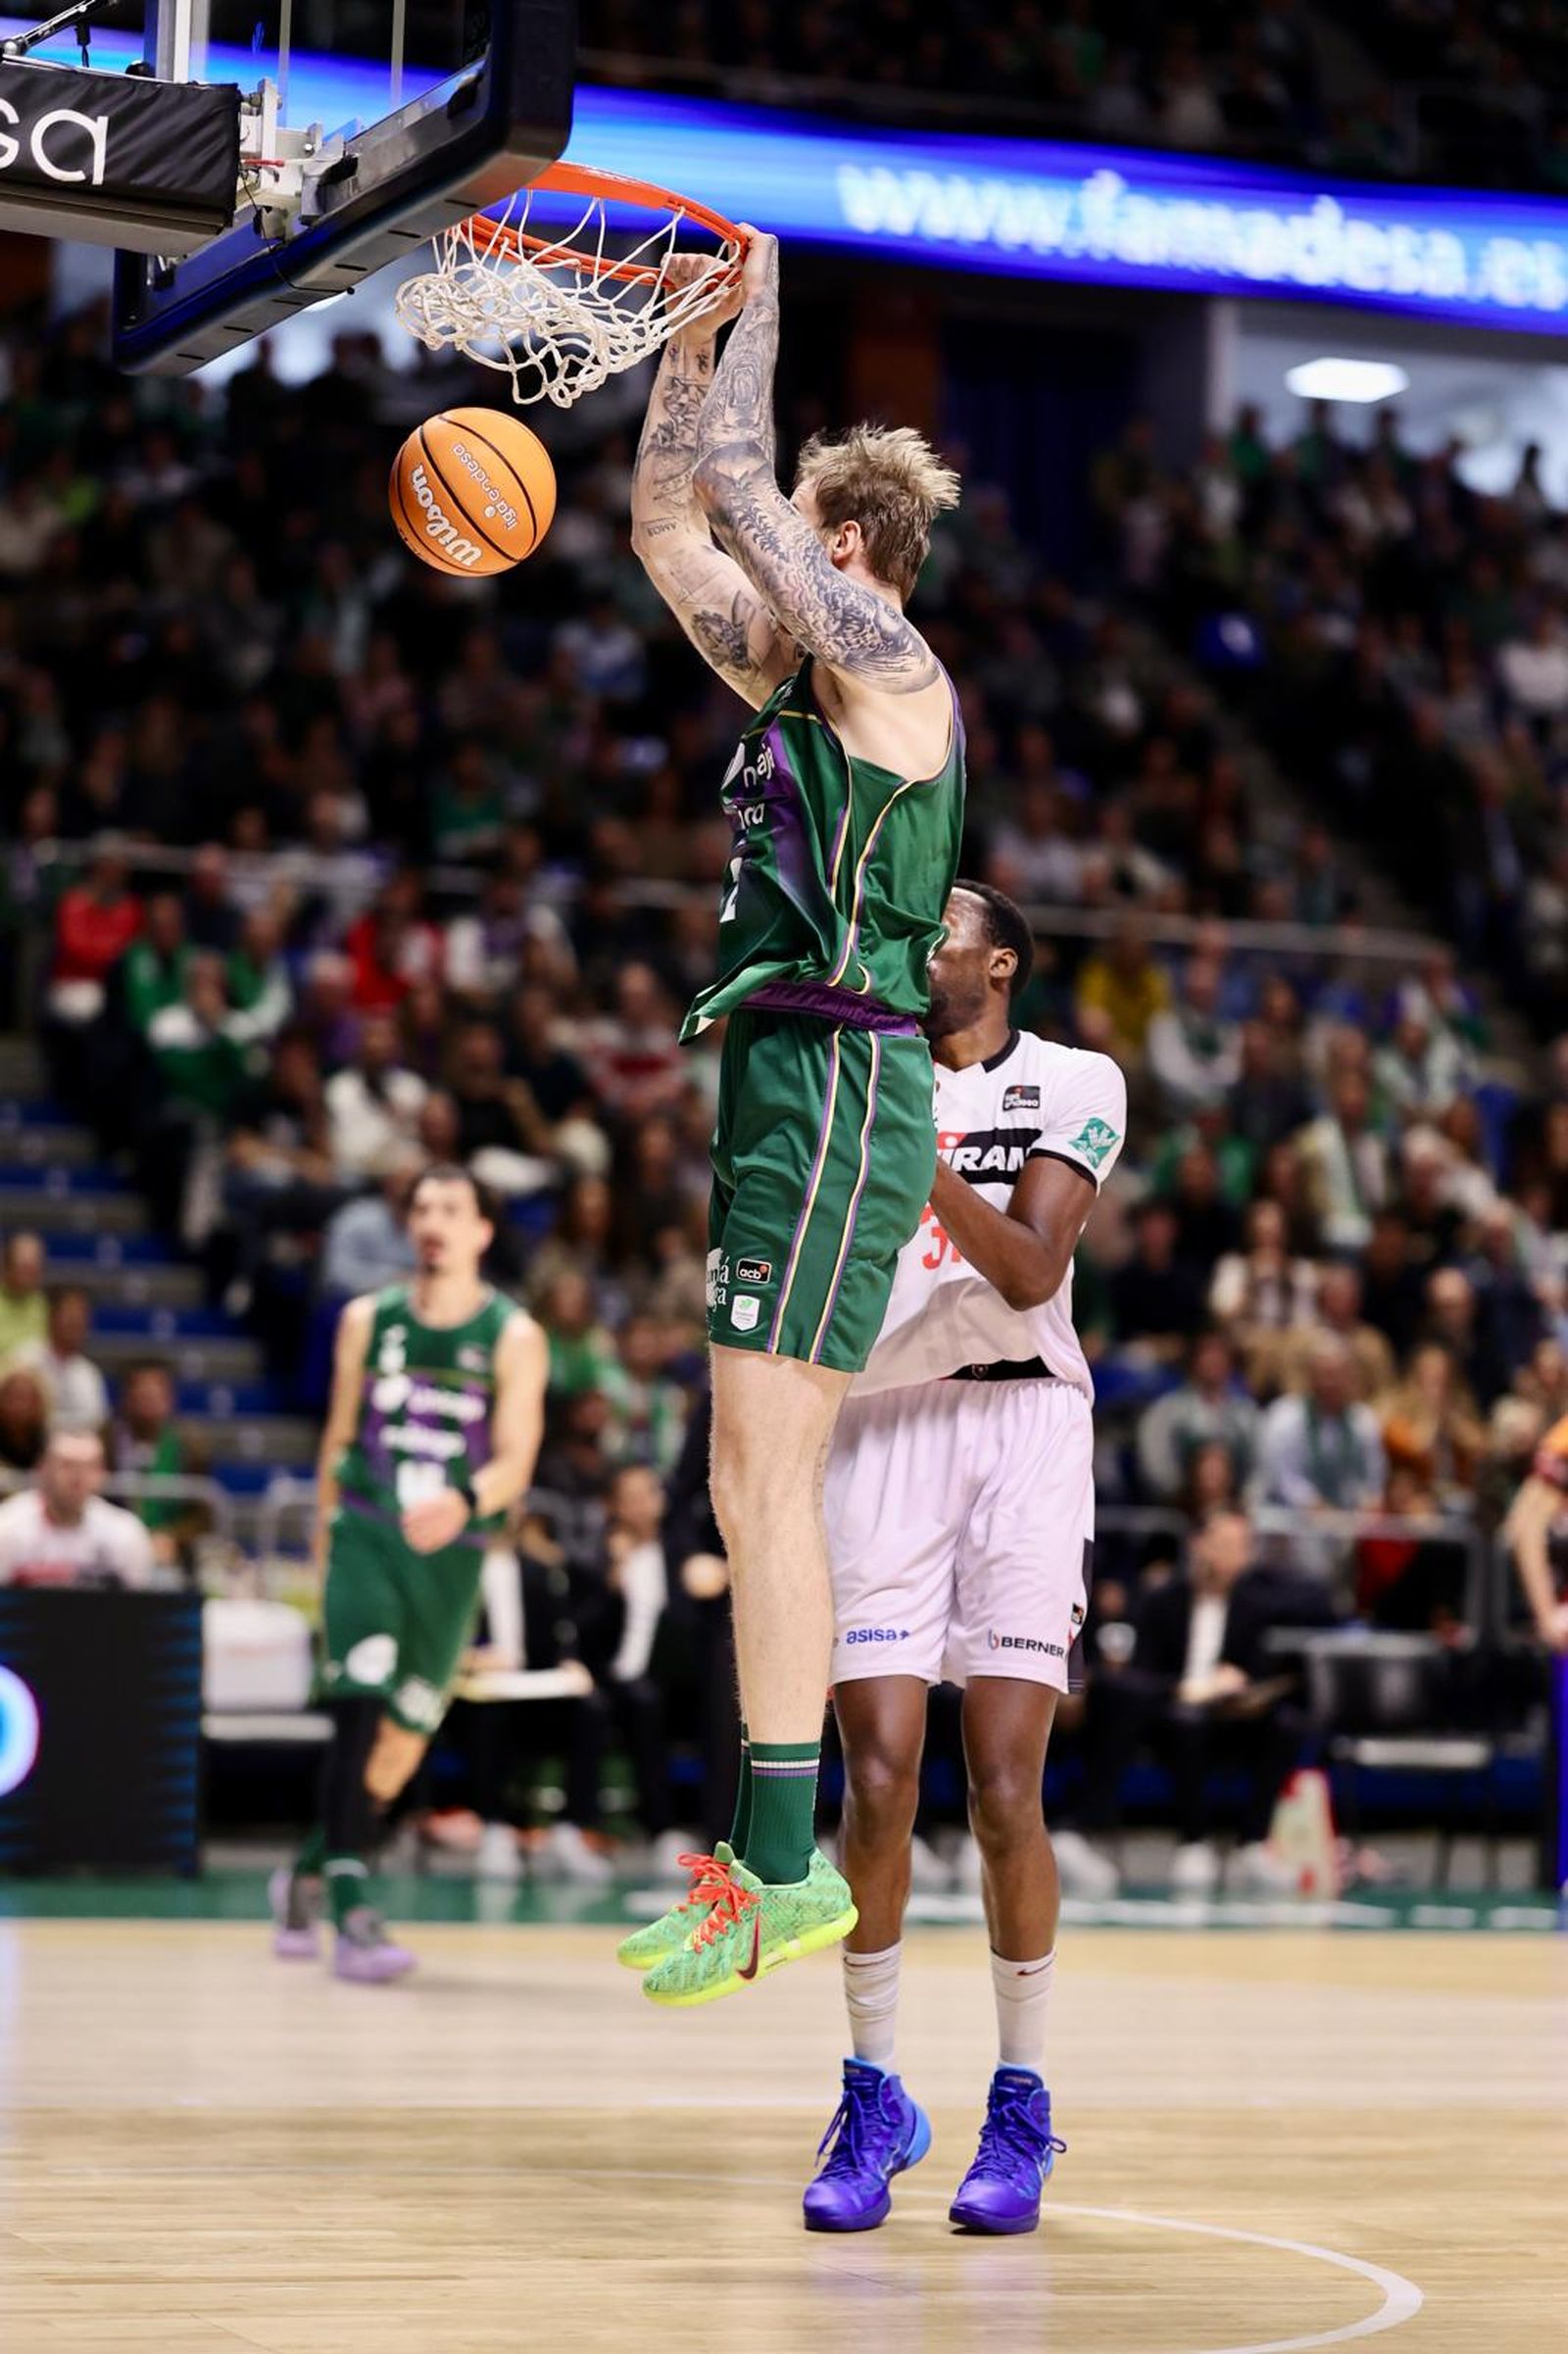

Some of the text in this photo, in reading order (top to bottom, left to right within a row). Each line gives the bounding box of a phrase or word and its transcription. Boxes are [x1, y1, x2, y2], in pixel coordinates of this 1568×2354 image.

[453, 443, 518, 530] liga endesa
[412, 465, 482, 566] Wilson
[739, 1268, 761, 1280] acb
[847, 1628, 897, 1644] asisa
[1001, 1636, 1065, 1658] BERNER
